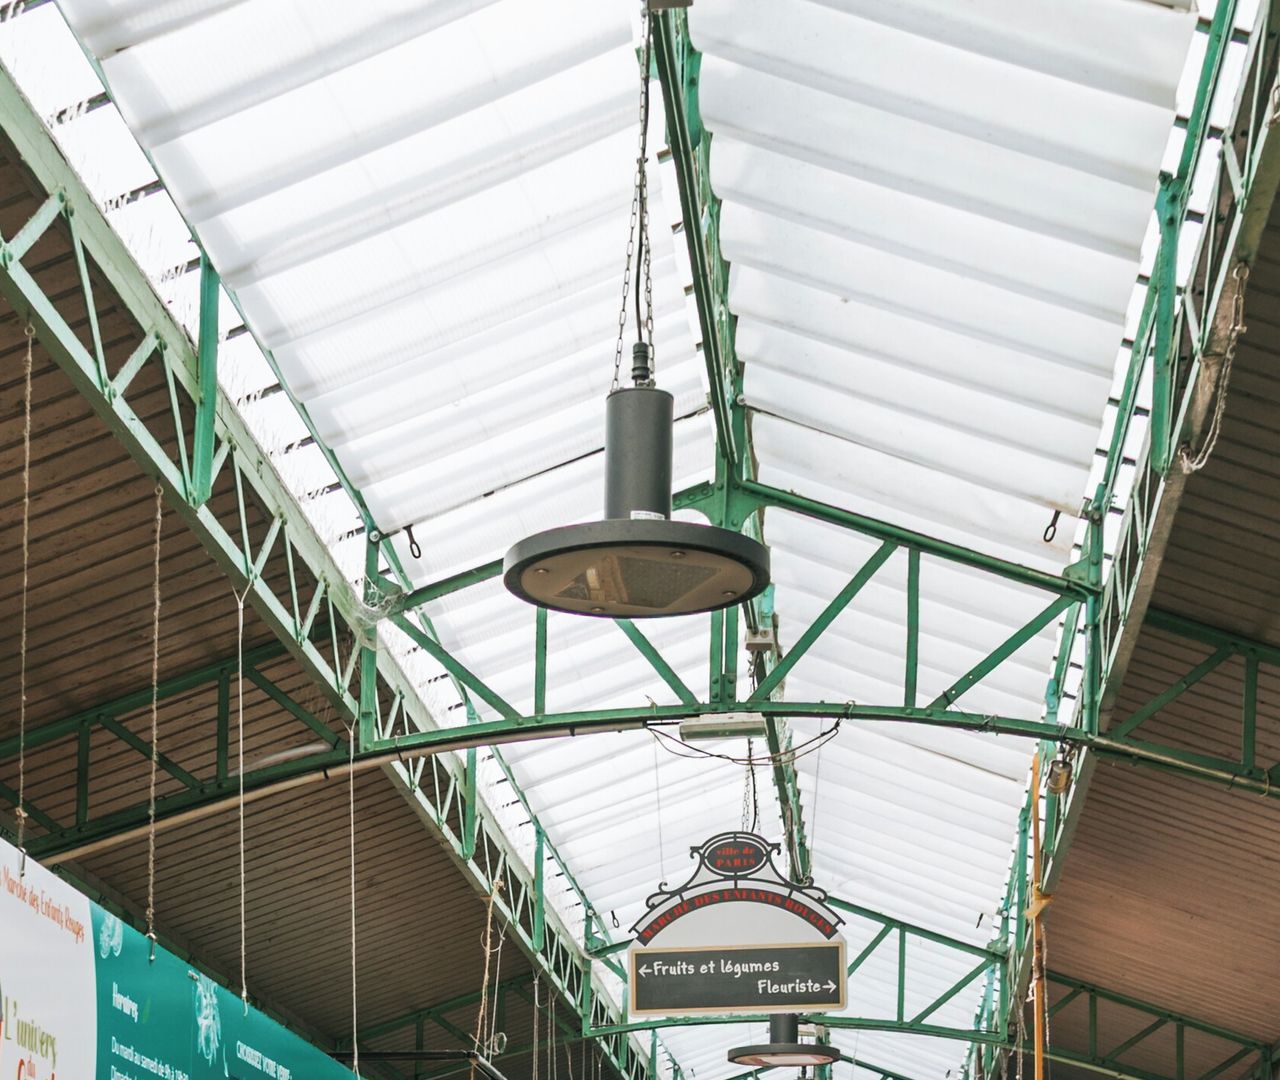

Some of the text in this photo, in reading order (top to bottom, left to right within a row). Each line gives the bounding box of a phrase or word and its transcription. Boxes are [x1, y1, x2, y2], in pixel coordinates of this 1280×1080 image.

[716, 846, 756, 856] ville de
[715, 857, 756, 868] PARIS
[694, 891, 720, 907] DES
[652, 959, 780, 978] Fruits et légumes
[757, 979, 821, 994] Fleuriste
